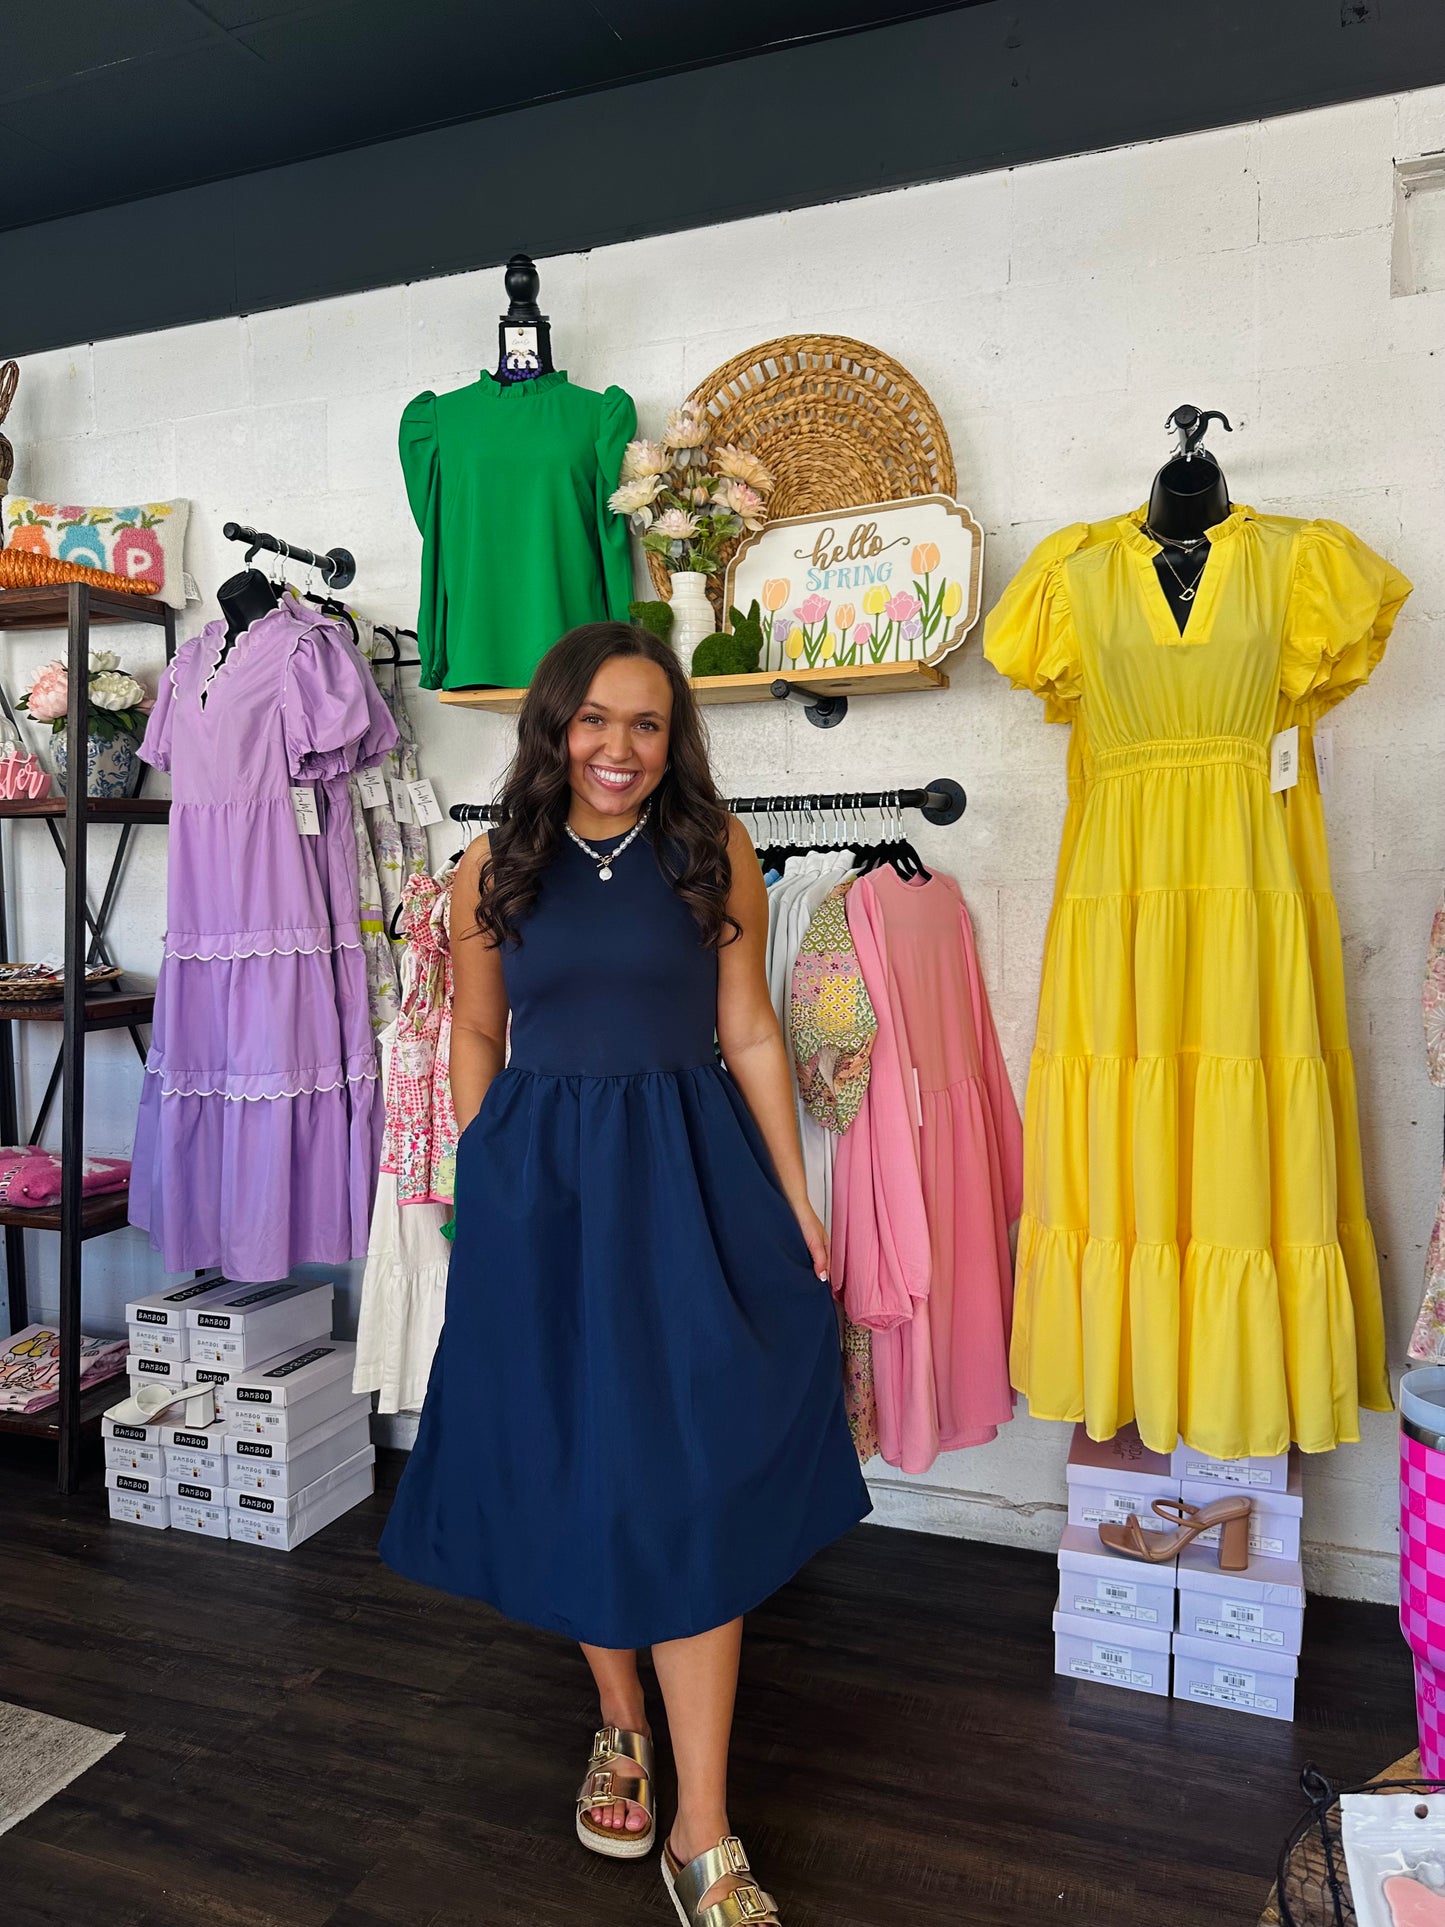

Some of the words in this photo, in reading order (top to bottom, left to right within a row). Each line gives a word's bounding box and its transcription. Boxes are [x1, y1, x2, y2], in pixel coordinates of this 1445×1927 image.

[793, 521, 911, 571] hello
[805, 561, 894, 592] SPRING
[137, 1311, 167, 1323] BAMBOO
[198, 1316, 230, 1328] BAMBOO
[140, 1361, 169, 1374] BAMBOO
[238, 1389, 271, 1401] BAMBOO
[114, 1427, 145, 1439] BAMBOO
[175, 1435, 207, 1447] BAMBOO
[238, 1444, 271, 1455] BAMBOO
[118, 1478, 148, 1490] BAMBOO
[179, 1486, 210, 1498] BAMBOO
[240, 1497, 273, 1511] BAMBOO
